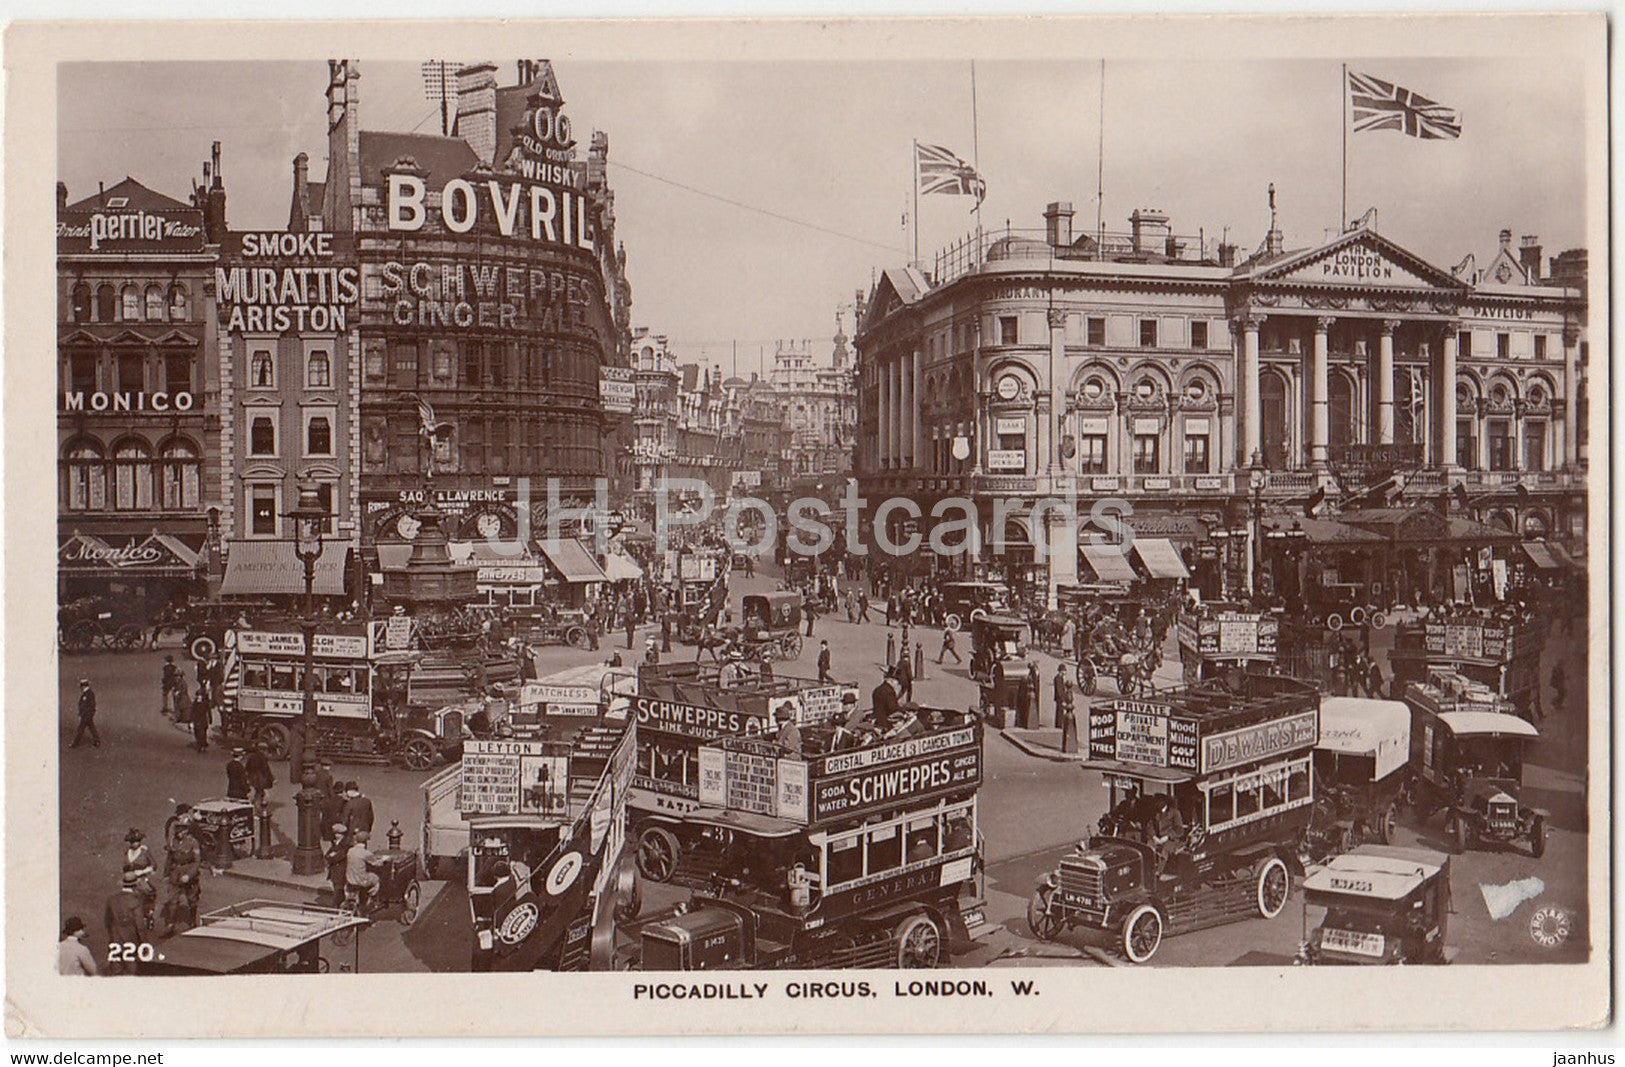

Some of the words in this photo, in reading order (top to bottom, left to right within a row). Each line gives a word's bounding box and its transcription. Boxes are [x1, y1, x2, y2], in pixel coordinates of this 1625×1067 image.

[521, 160, 580, 187] WHISKY
[388, 174, 594, 250] BOVRIL
[90, 210, 165, 250] perrier
[241, 233, 334, 256] SMOKE
[1335, 254, 1381, 267] LONDON
[1323, 264, 1392, 278] PAVILION
[215, 266, 358, 304] MURATTIS
[382, 261, 592, 306] SCHWEPPES
[228, 305, 347, 332] ARISTON
[393, 300, 518, 329] GINGER
[1473, 306, 1533, 319] PAVILION
[65, 391, 193, 411] MONICO
[446, 490, 506, 502] LAWRENCE
[65, 541, 162, 567] Monico
[235, 561, 273, 571] AMERY
[268, 635, 300, 647] JAMES
[530, 687, 589, 698] MATCHLESS
[637, 698, 740, 732] SCHWEPPES
[1117, 702, 1166, 715] PRIVATE
[659, 720, 683, 733] LIME
[1090, 713, 1114, 726] WOOD
[1124, 713, 1159, 727] PRIVATE
[1170, 720, 1196, 733] Wood
[1090, 726, 1115, 740] MILNE
[1117, 731, 1166, 746] DEPARTMENT
[1170, 732, 1196, 745] Milne
[921, 736, 950, 751] CAMDEN
[951, 730, 973, 745] TOWN
[1208, 722, 1293, 768] DEWAR'S
[478, 743, 532, 754] LEYTON
[1090, 742, 1115, 754] TYRES
[1171, 746, 1196, 757] GOLF
[827, 754, 864, 773] CRYSTAL
[870, 746, 902, 764] PALACE
[954, 755, 976, 768] GINGER
[1170, 756, 1196, 768] BALLS
[849, 760, 951, 807] SCHWEPPES
[952, 771, 965, 782] ALE
[821, 785, 846, 799] SODA
[818, 799, 848, 813] WATER
[853, 871, 939, 904] GENERAL
